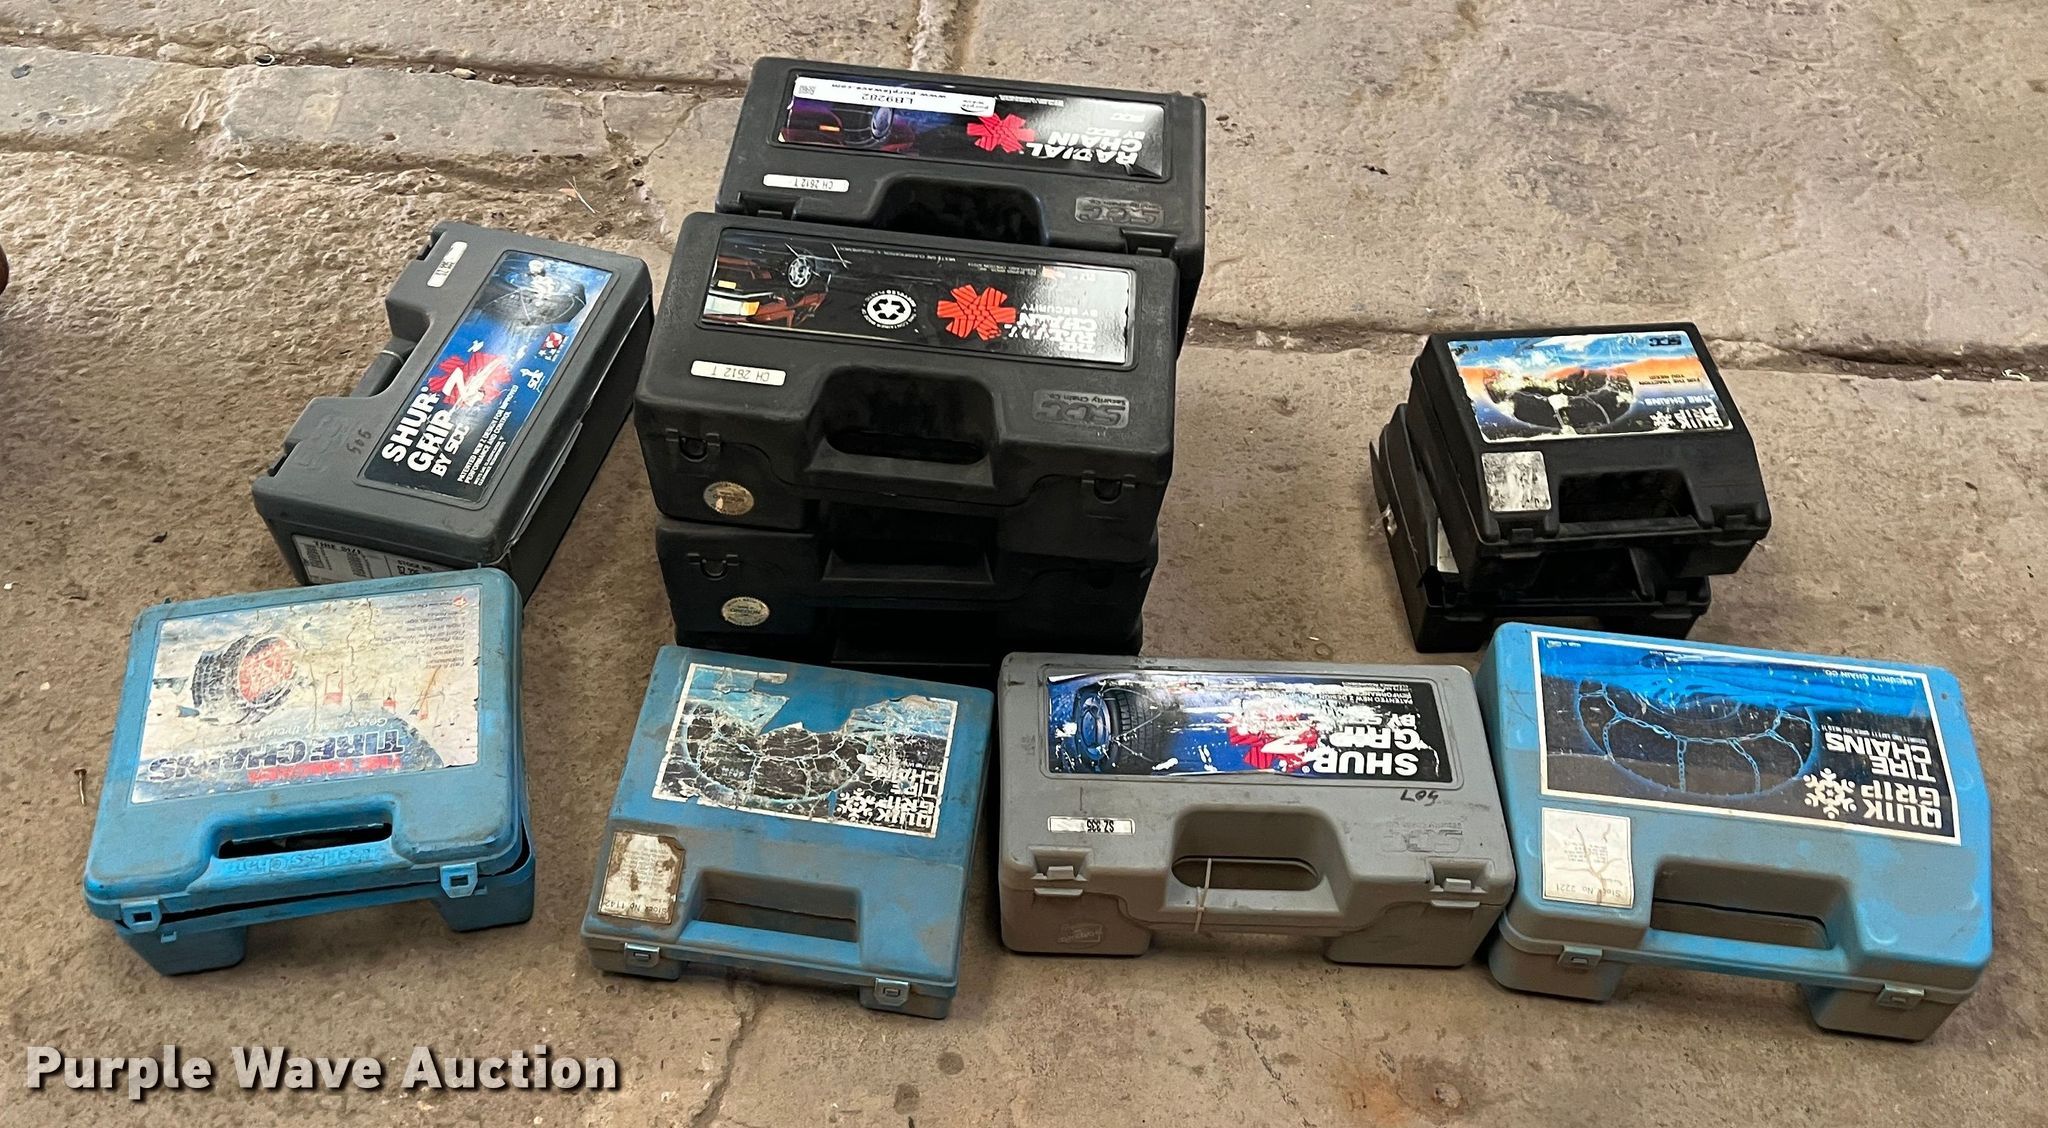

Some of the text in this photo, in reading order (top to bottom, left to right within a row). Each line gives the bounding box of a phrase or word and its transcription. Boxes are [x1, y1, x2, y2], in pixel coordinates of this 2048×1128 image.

[861, 94, 914, 105] LB9282
[1047, 131, 1143, 153] CHAIN
[1026, 143, 1139, 166] RADIAL
[1020, 302, 1078, 315] SECURITY
[711, 365, 770, 382] CH 2612 T
[381, 392, 441, 462] SHUR
[407, 409, 456, 472] GRIP
[456, 453, 478, 483] PATENTED
[482, 418, 498, 440] DESIGN
[431, 453, 452, 477] BY
[1840, 671, 1869, 682] CHAIN
[1329, 726, 1421, 750] GRIP
[1825, 731, 1933, 765] CHAINS
[1869, 755, 1937, 783] TIRE
[1861, 780, 1941, 808] GRIP
[1862, 799, 1943, 829] QUIK
[1103, 820, 1114, 834] SZ
